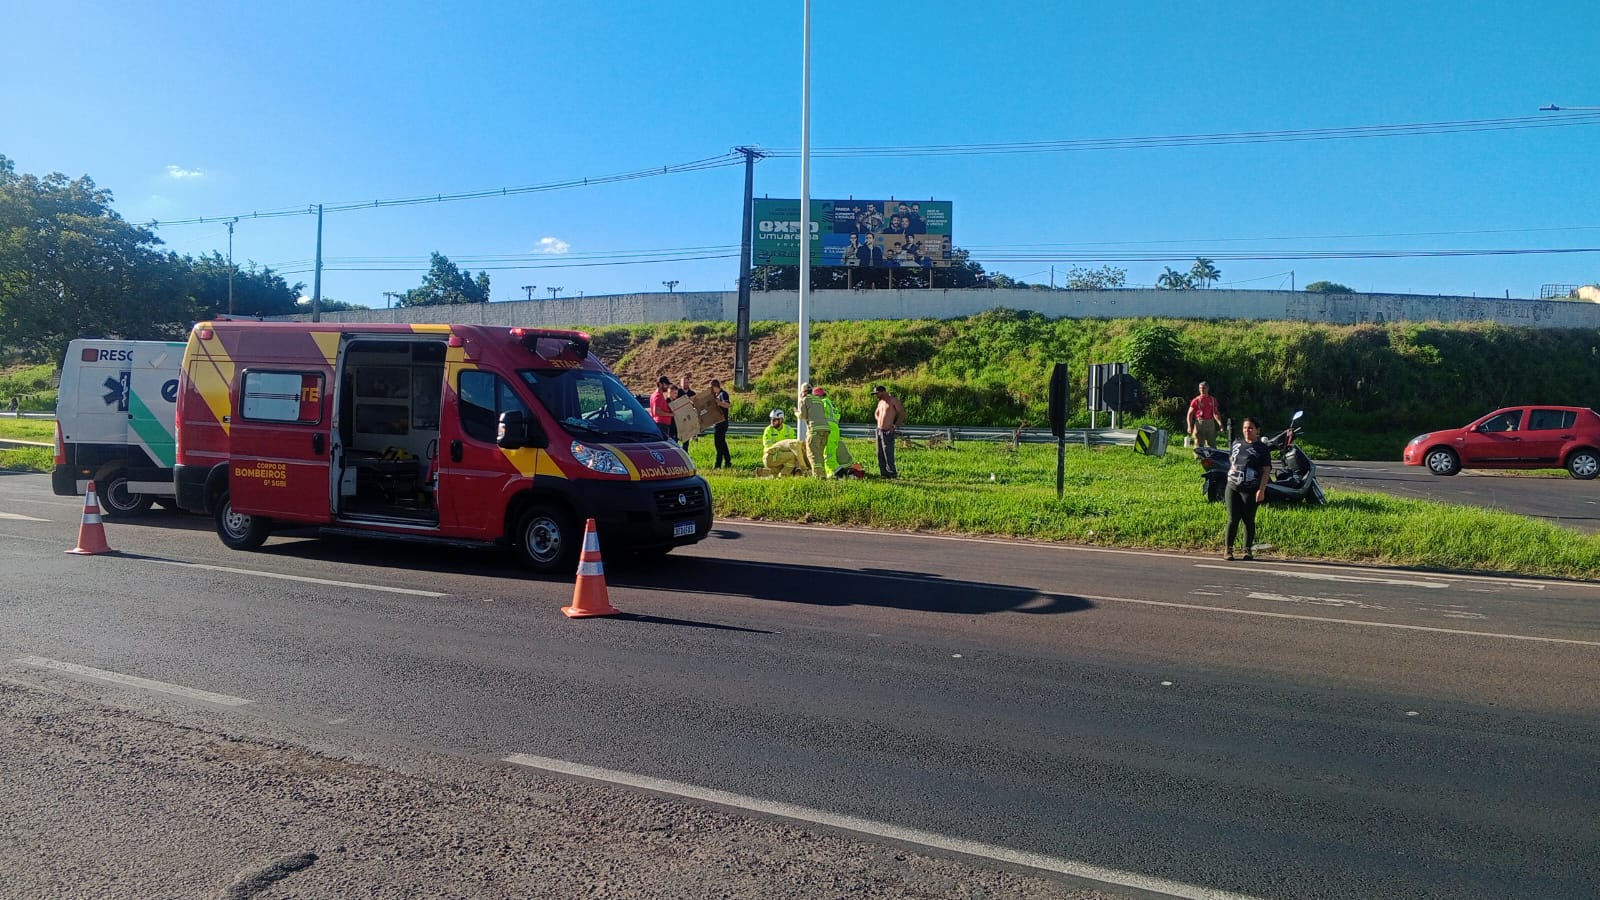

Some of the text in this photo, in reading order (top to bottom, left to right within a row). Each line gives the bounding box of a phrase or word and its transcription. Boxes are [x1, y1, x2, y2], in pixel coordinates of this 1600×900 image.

[759, 233, 819, 241] umuaraa
[256, 462, 277, 470] CORPO
[235, 467, 287, 479] BOMBEIROS
